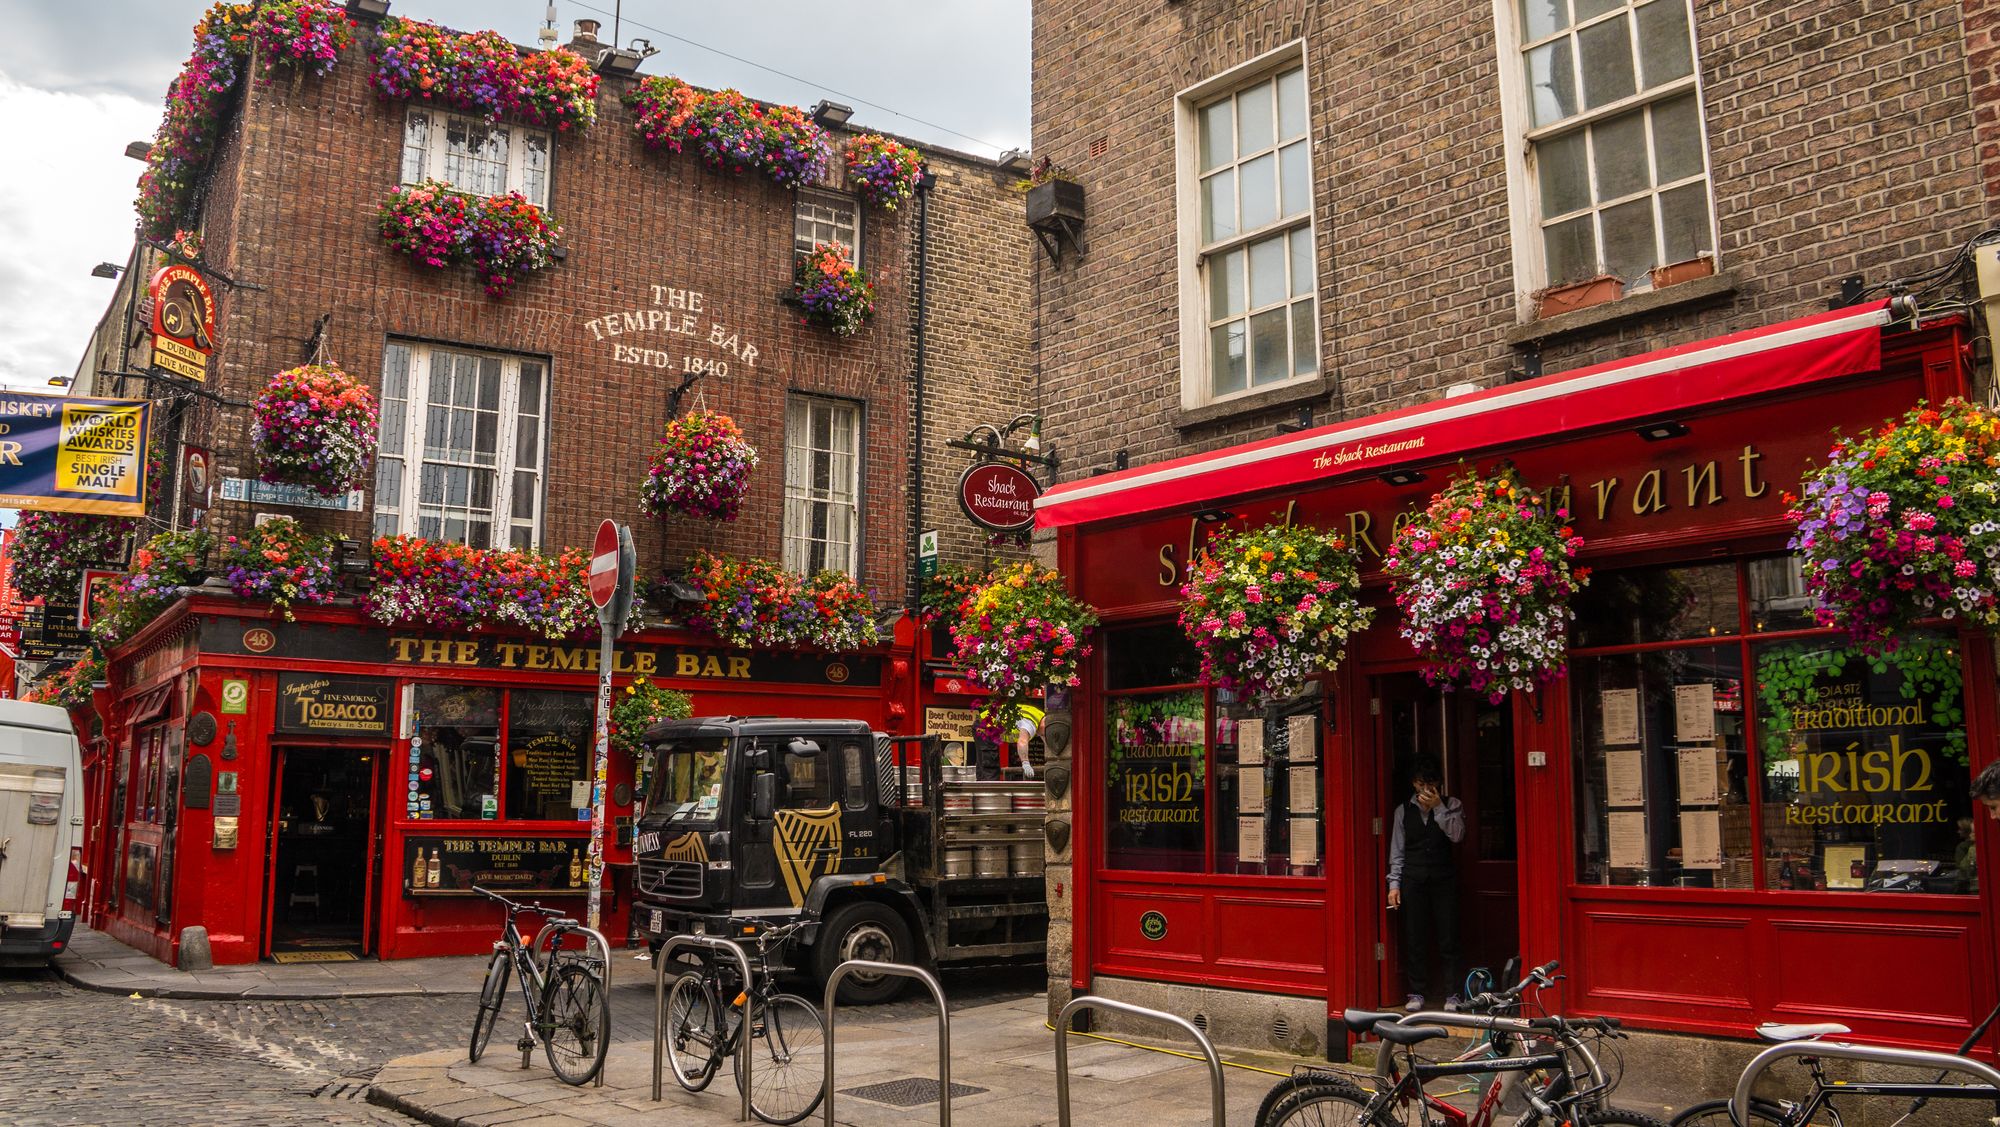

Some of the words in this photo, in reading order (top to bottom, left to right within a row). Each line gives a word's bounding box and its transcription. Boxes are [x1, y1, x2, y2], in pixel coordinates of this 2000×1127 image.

[158, 277, 171, 302] THE
[170, 270, 206, 294] TEMPLE
[204, 296, 212, 324] BAR
[651, 285, 703, 312] THE
[585, 310, 697, 341] TEMPLE
[707, 323, 759, 367] BAR
[167, 341, 197, 361] DUBLIN
[160, 355, 176, 369] LIVE
[178, 363, 201, 378] MUSIC
[614, 343, 673, 369] ESTD.
[683, 357, 728, 377] 1840
[0, 401, 56, 417] ISKEY
[69, 413, 136, 428] WORLD
[68, 427, 135, 439] WHISKIES
[66, 436, 134, 451] AWARDS
[0, 441, 23, 466] R
[76, 454, 97, 463] BEST
[100, 455, 122, 464] IRISH
[1313, 452, 1331, 469] The
[1364, 436, 1425, 459] Restaurant
[71, 463, 125, 477] SINGLE
[76, 475, 119, 488] MALT
[251, 492, 283, 502] TEMPLE
[286, 496, 309, 505] LANE
[312, 498, 342, 507] SOUTH
[974, 494, 1030, 511] Restaurant
[248, 633, 269, 647] 48
[390, 637, 479, 665] THE
[677, 654, 751, 678] BAR
[829, 667, 845, 679] 48
[282, 679, 330, 696] Importers
[295, 697, 377, 724] TOBACCO
[928, 711, 944, 720] Beer
[947, 712, 973, 721] Garden
[1793, 699, 1926, 730] traditional
[310, 720, 342, 728] Always
[928, 721, 958, 731] Smoking
[527, 736, 560, 749] TEMPLE
[561, 738, 577, 751] BAR
[1126, 742, 1191, 758] traditional
[1120, 806, 1200, 822] restaurant
[1786, 799, 1949, 825] restaurant
[444, 840, 474, 852] THE
[478, 840, 535, 853] TEMPLE
[539, 841, 567, 853] BAR
[854, 848, 868, 856] 31
